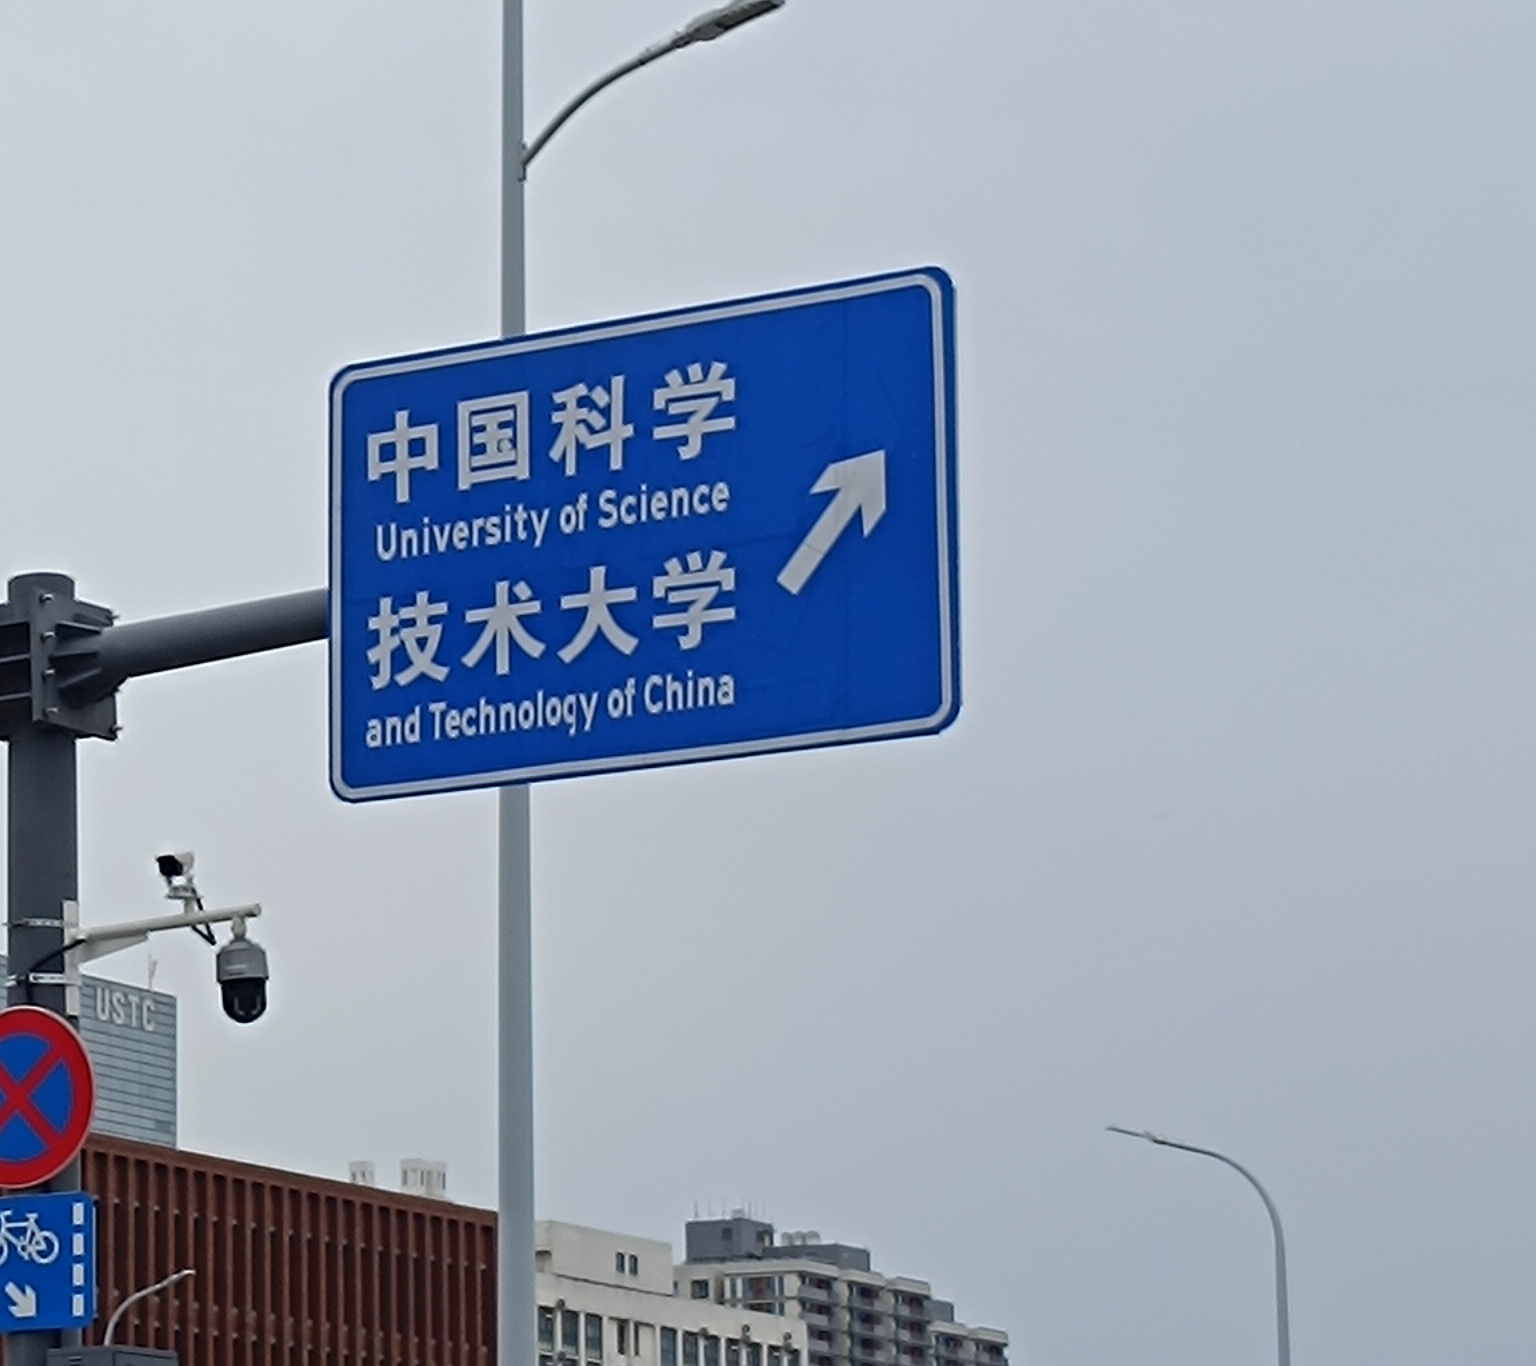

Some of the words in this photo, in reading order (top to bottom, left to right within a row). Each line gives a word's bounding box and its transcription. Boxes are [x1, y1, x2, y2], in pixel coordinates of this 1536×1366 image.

[367, 361, 736, 503] 中国科学
[377, 504, 550, 561] University
[559, 494, 588, 534] of
[598, 482, 730, 528] Science
[367, 550, 736, 690] 技术大学
[366, 705, 420, 748] and
[428, 690, 598, 740] Technology
[607, 677, 636, 718] of
[644, 670, 734, 714] China
[96, 987, 157, 1032] USTC
